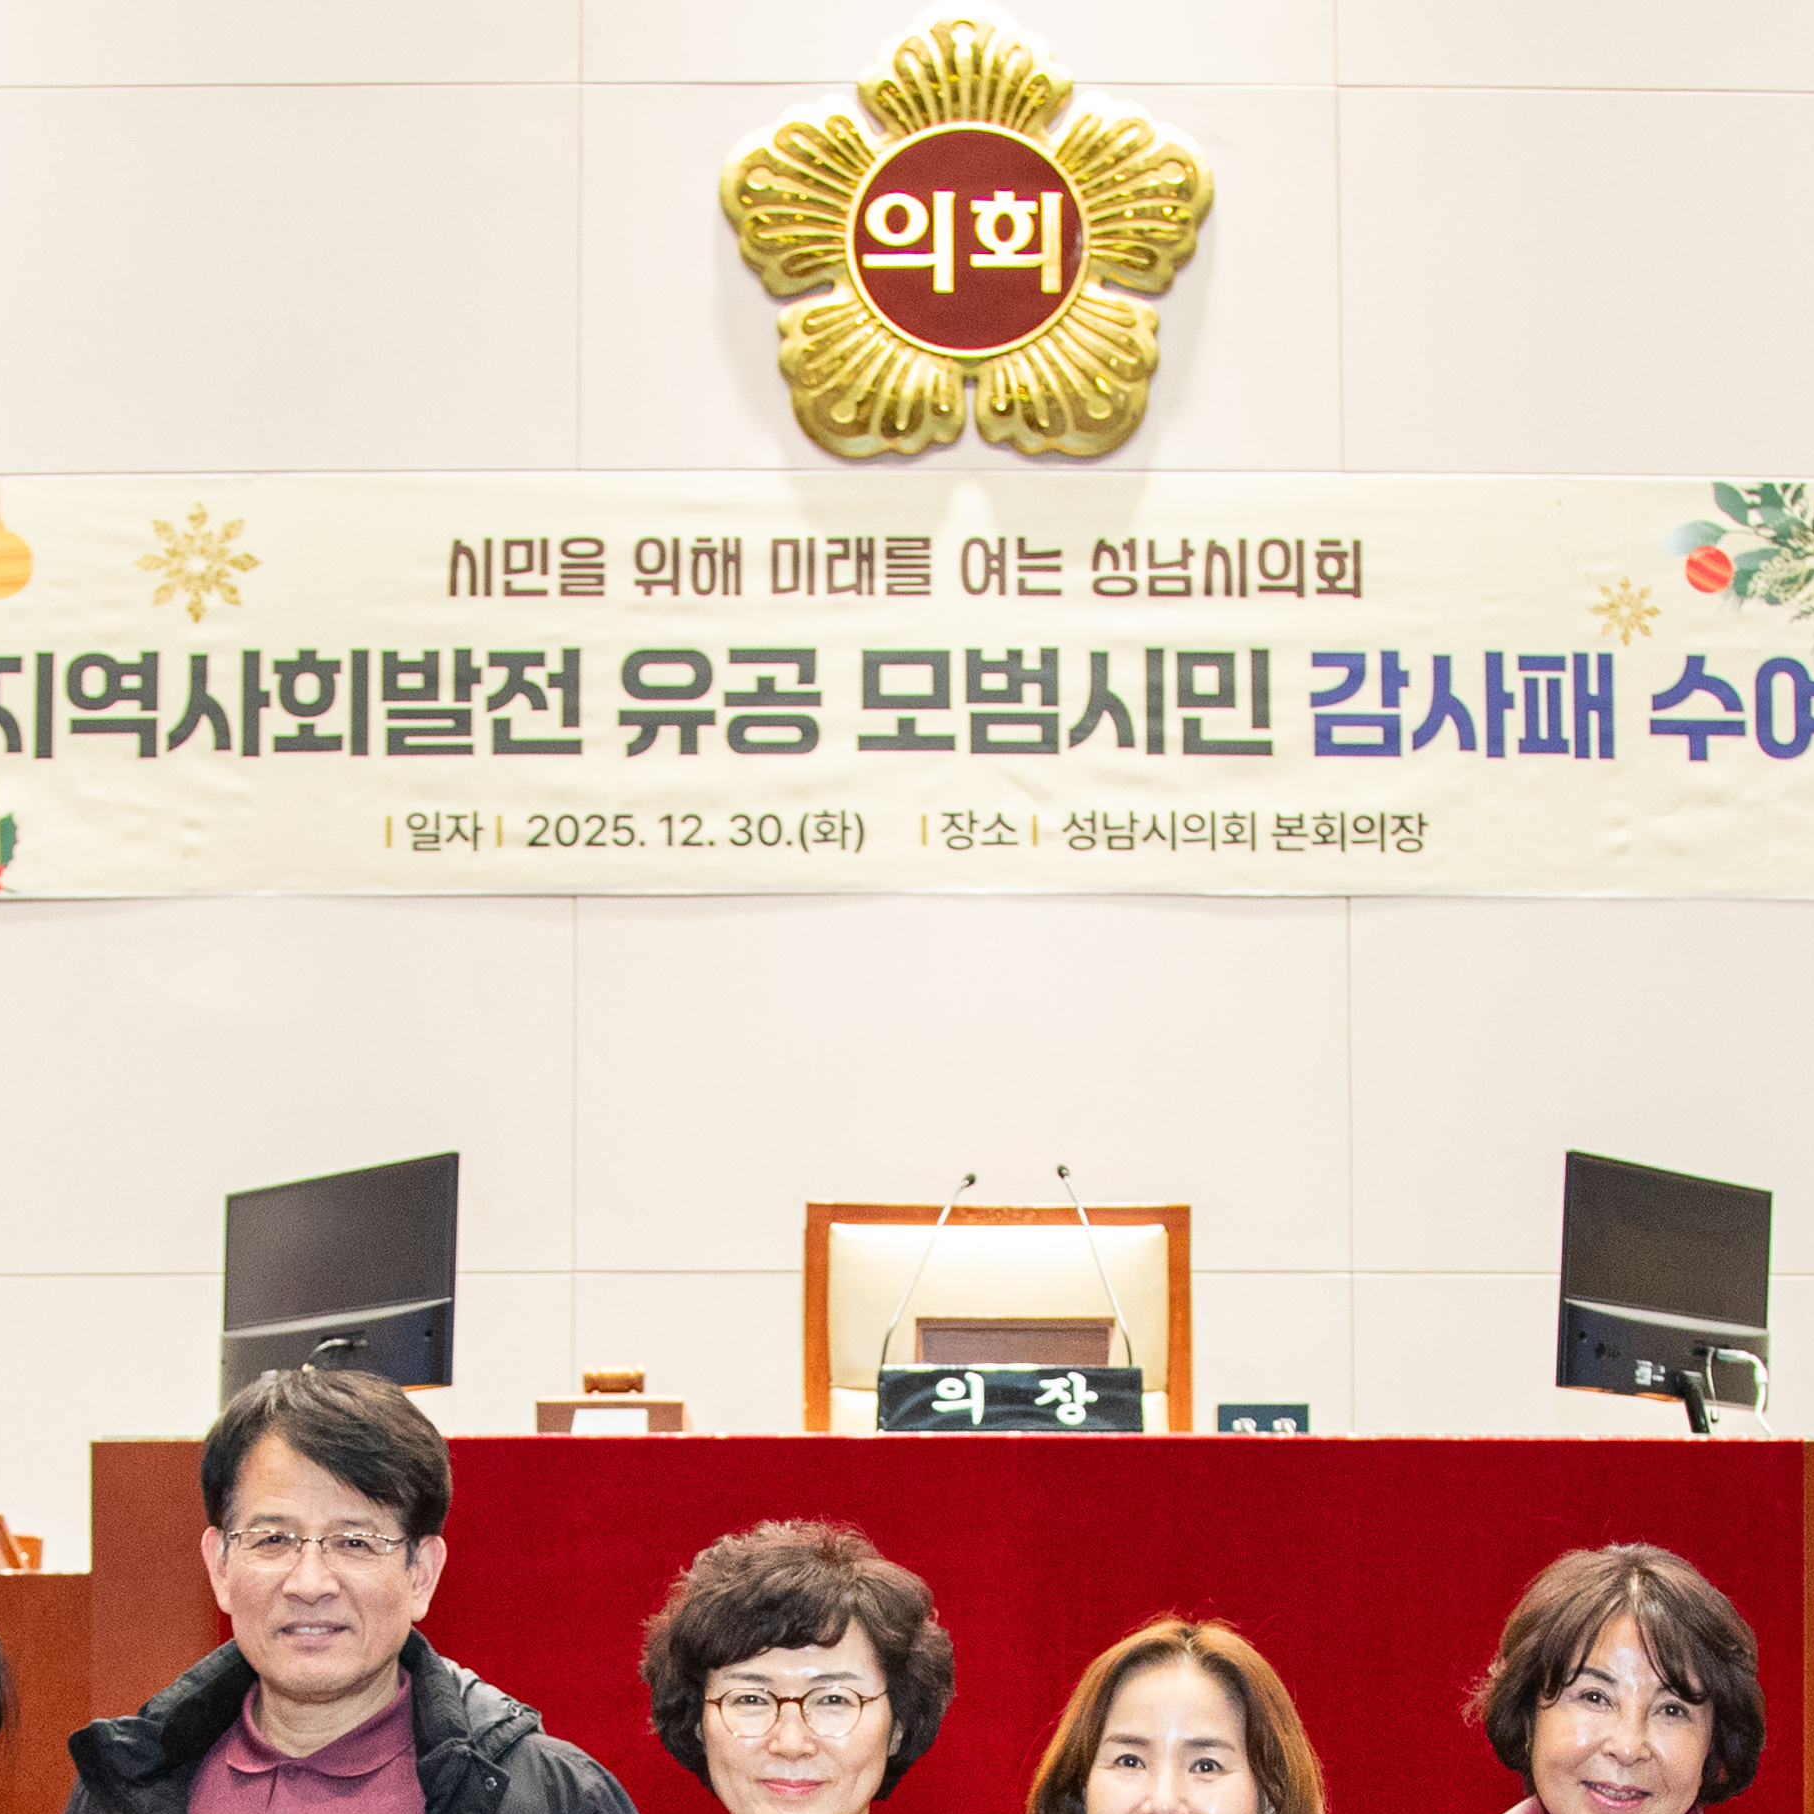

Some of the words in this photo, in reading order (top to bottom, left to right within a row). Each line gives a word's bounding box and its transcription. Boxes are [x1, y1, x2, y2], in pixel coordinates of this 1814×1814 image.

[861, 189, 1064, 294] 의회
[448, 536, 606, 597] 시민을
[634, 537, 742, 597] 위해
[771, 536, 932, 597] 미래를
[960, 536, 1063, 597] 여는
[1090, 537, 1363, 599] 성남시의회
[617, 647, 823, 758] 유공
[857, 647, 1274, 757] 모범시민
[1309, 649, 1615, 760] 감사패
[405, 813, 483, 852] 일자
[526, 813, 646, 848] 2025.
[659, 813, 716, 848] 12.
[728, 811, 866, 853] 30.(화)
[940, 812, 1019, 851] 장소
[1061, 811, 1257, 853] 성남시의회
[1271, 811, 1429, 853] 본회의장
